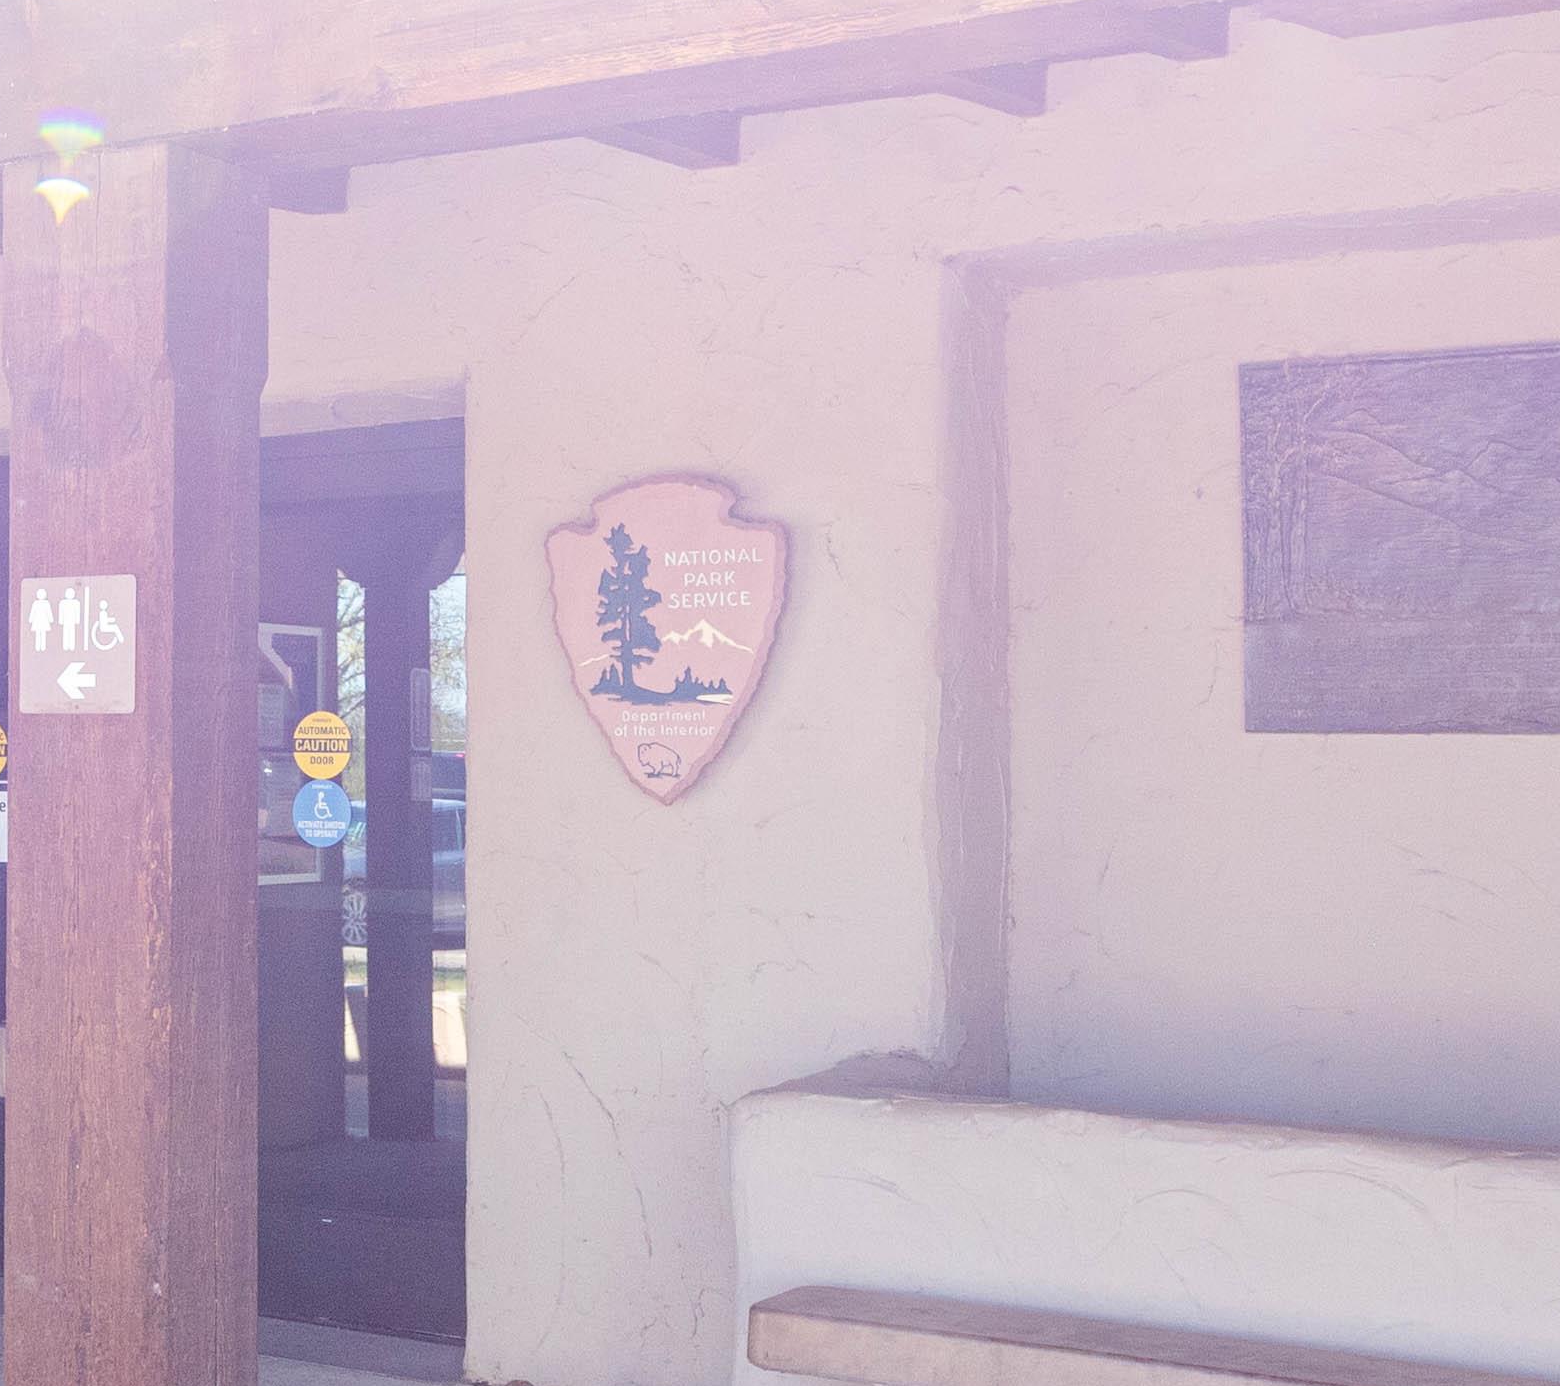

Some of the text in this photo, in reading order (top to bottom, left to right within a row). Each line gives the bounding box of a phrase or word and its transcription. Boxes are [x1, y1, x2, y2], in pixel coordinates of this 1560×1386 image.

[663, 547, 764, 567] NATIONAL
[683, 570, 736, 587] PARK
[667, 590, 752, 610] SERVICE
[621, 709, 706, 724] Department
[297, 726, 347, 735] AUTOMATIC
[614, 724, 716, 737] of the Interior
[295, 739, 349, 752] CAUTION
[309, 756, 335, 765] DOOR
